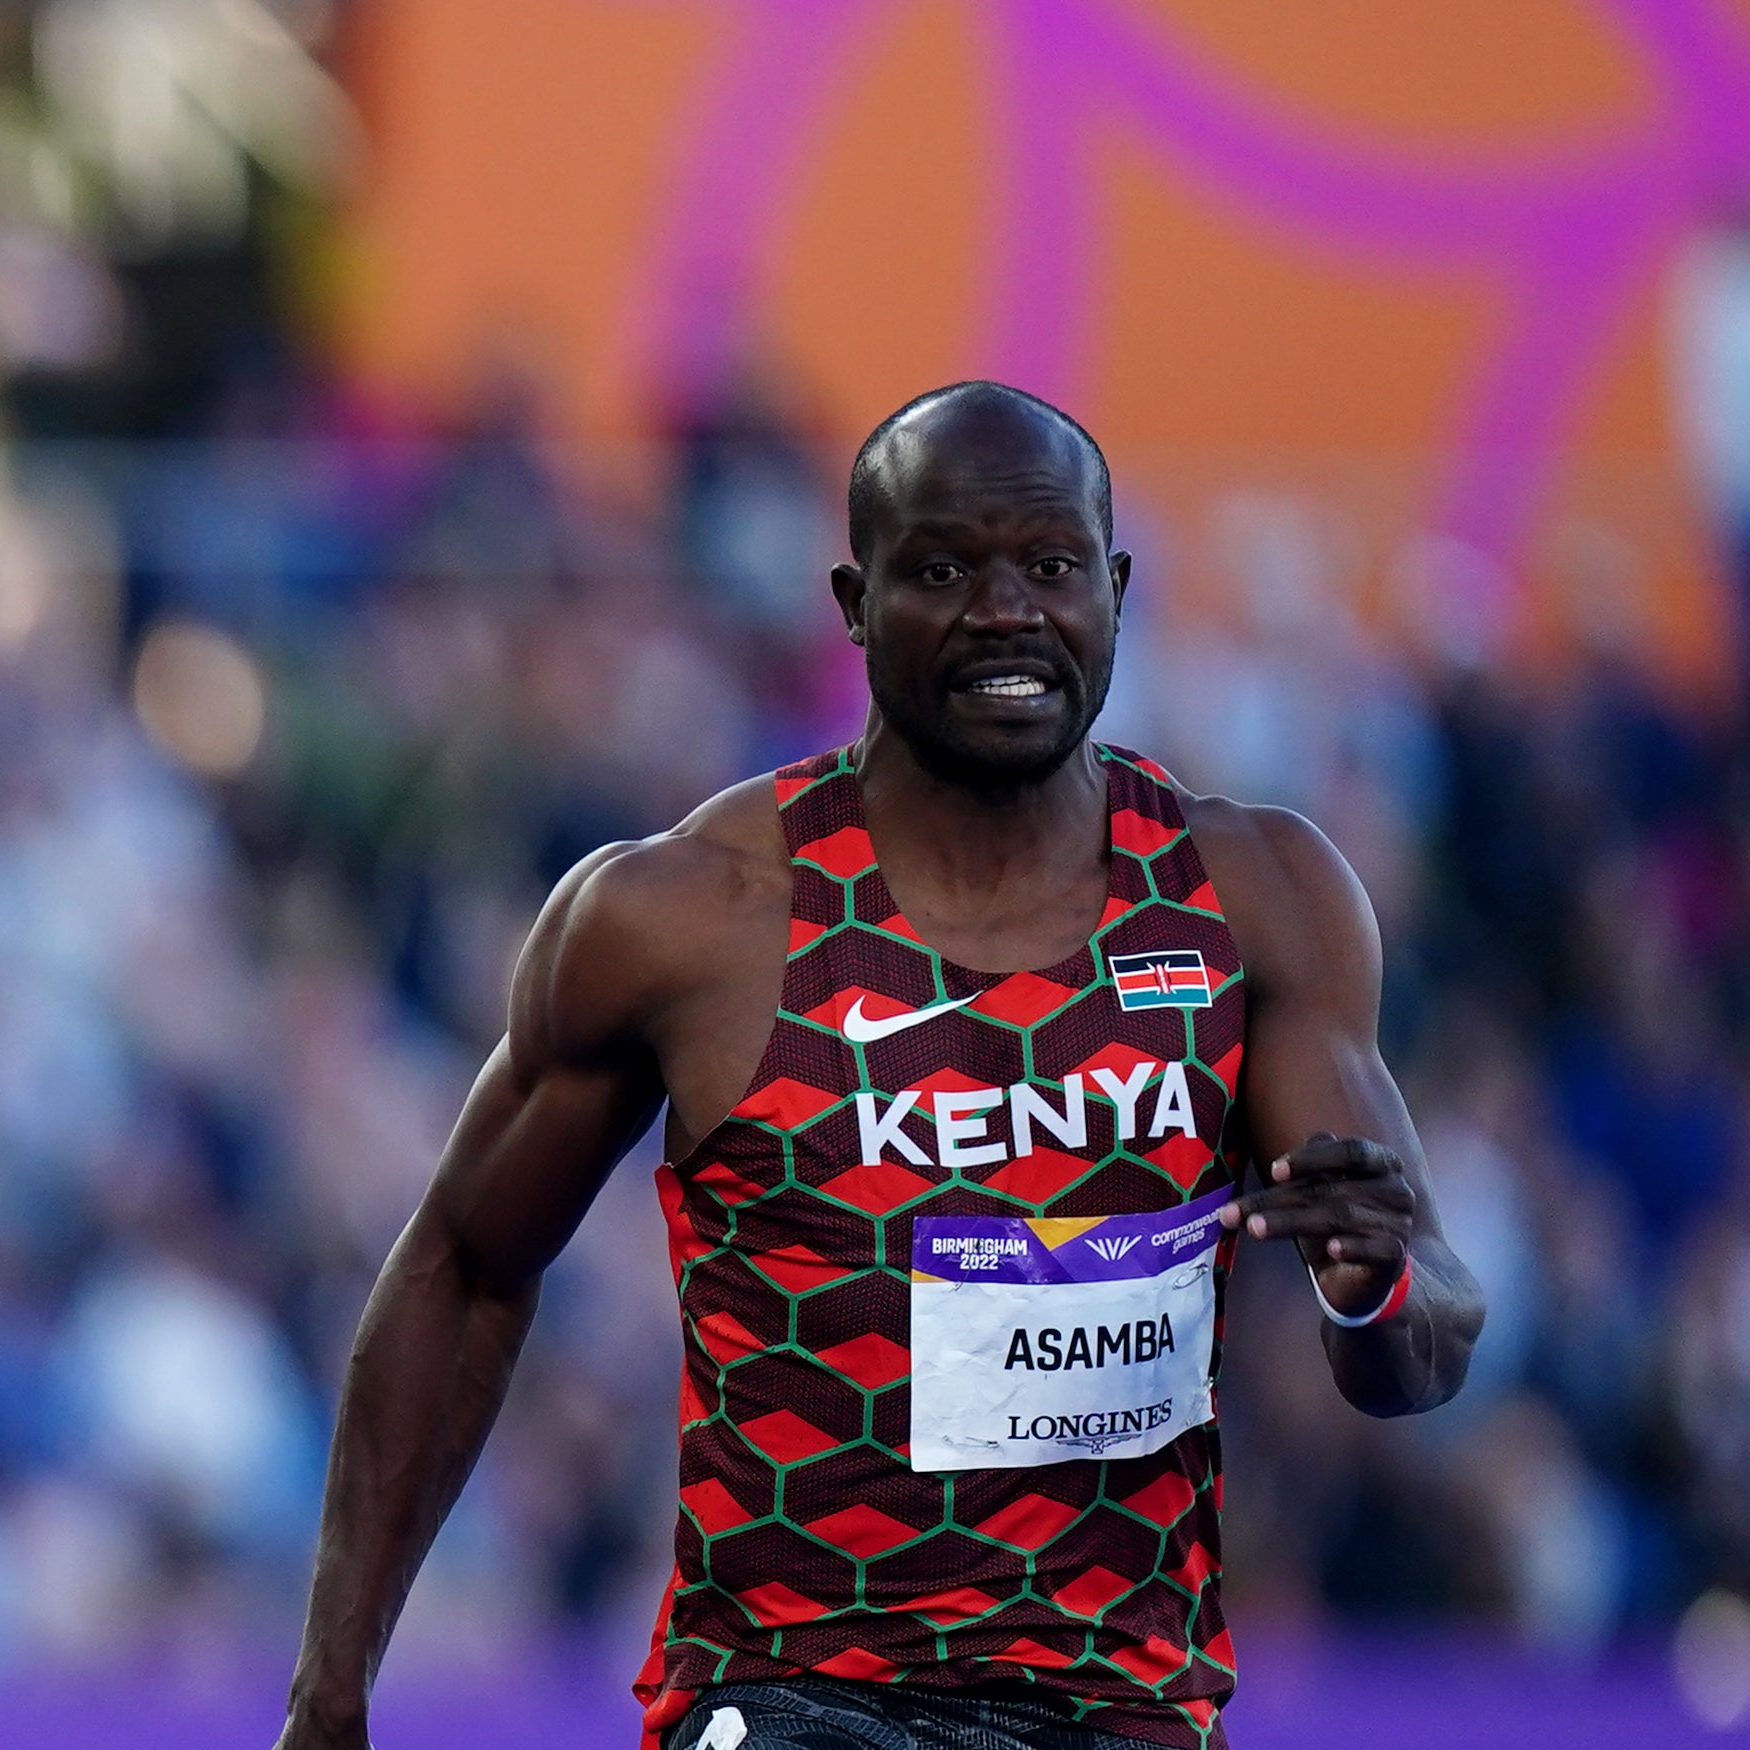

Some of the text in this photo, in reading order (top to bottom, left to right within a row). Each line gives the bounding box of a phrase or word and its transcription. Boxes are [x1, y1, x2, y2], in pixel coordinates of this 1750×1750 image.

[855, 1061, 1198, 1168] KENYA
[932, 1237, 1028, 1256] BIRMINGHAM
[1172, 1227, 1206, 1254] games
[960, 1253, 999, 1270] 2022
[1004, 1312, 1175, 1371] ASAMBA
[1008, 1397, 1173, 1440] LONGINES
